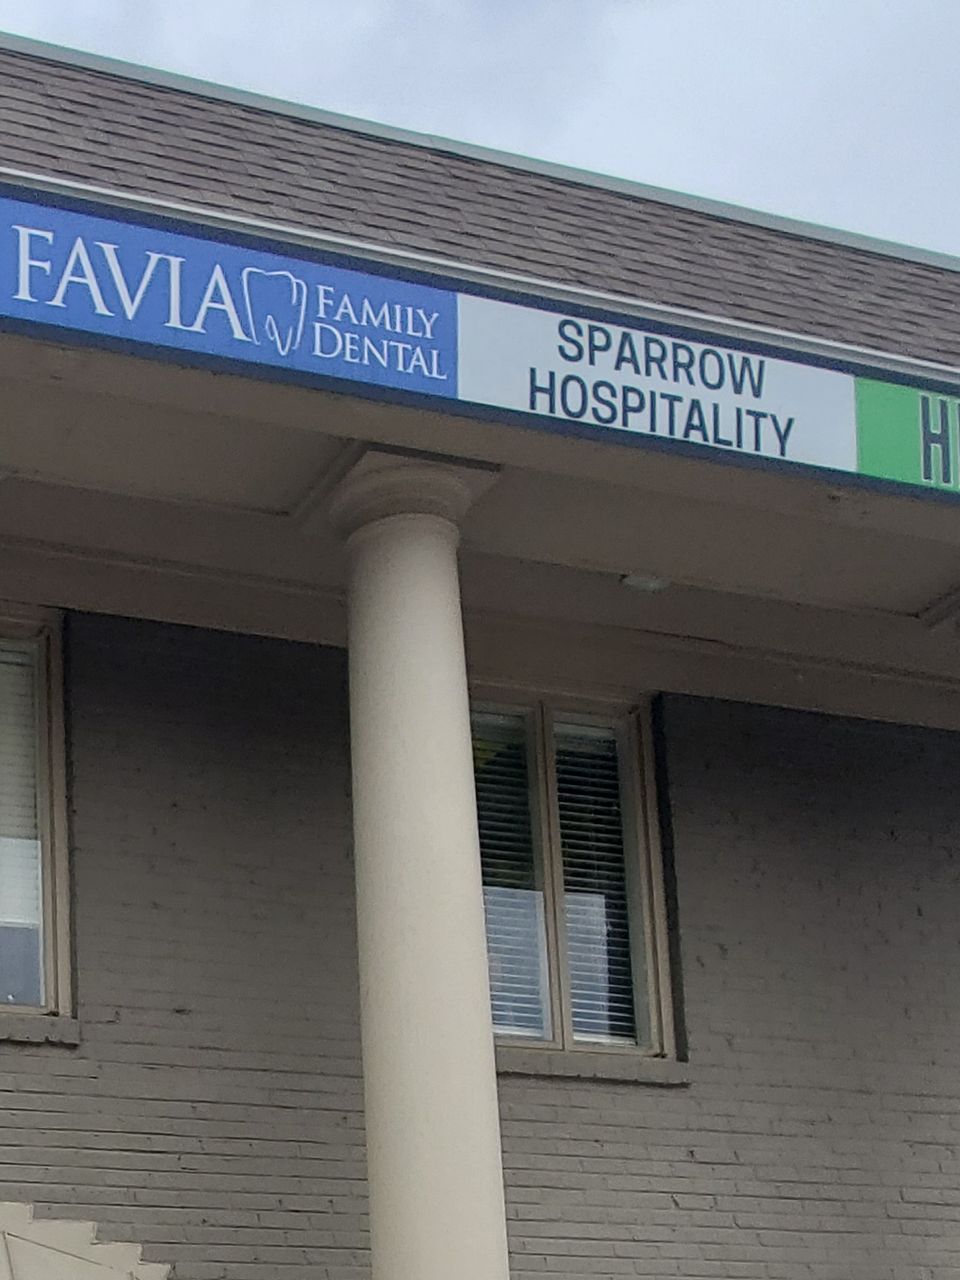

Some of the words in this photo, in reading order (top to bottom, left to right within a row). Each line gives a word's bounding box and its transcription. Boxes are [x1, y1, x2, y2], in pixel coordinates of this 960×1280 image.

[11, 224, 253, 342] FAVIA
[316, 284, 439, 339] FAMILY
[312, 321, 447, 380] DENTAL
[557, 318, 765, 399] SPARROW
[529, 366, 795, 457] HOSPITALITY
[920, 393, 960, 484] H
